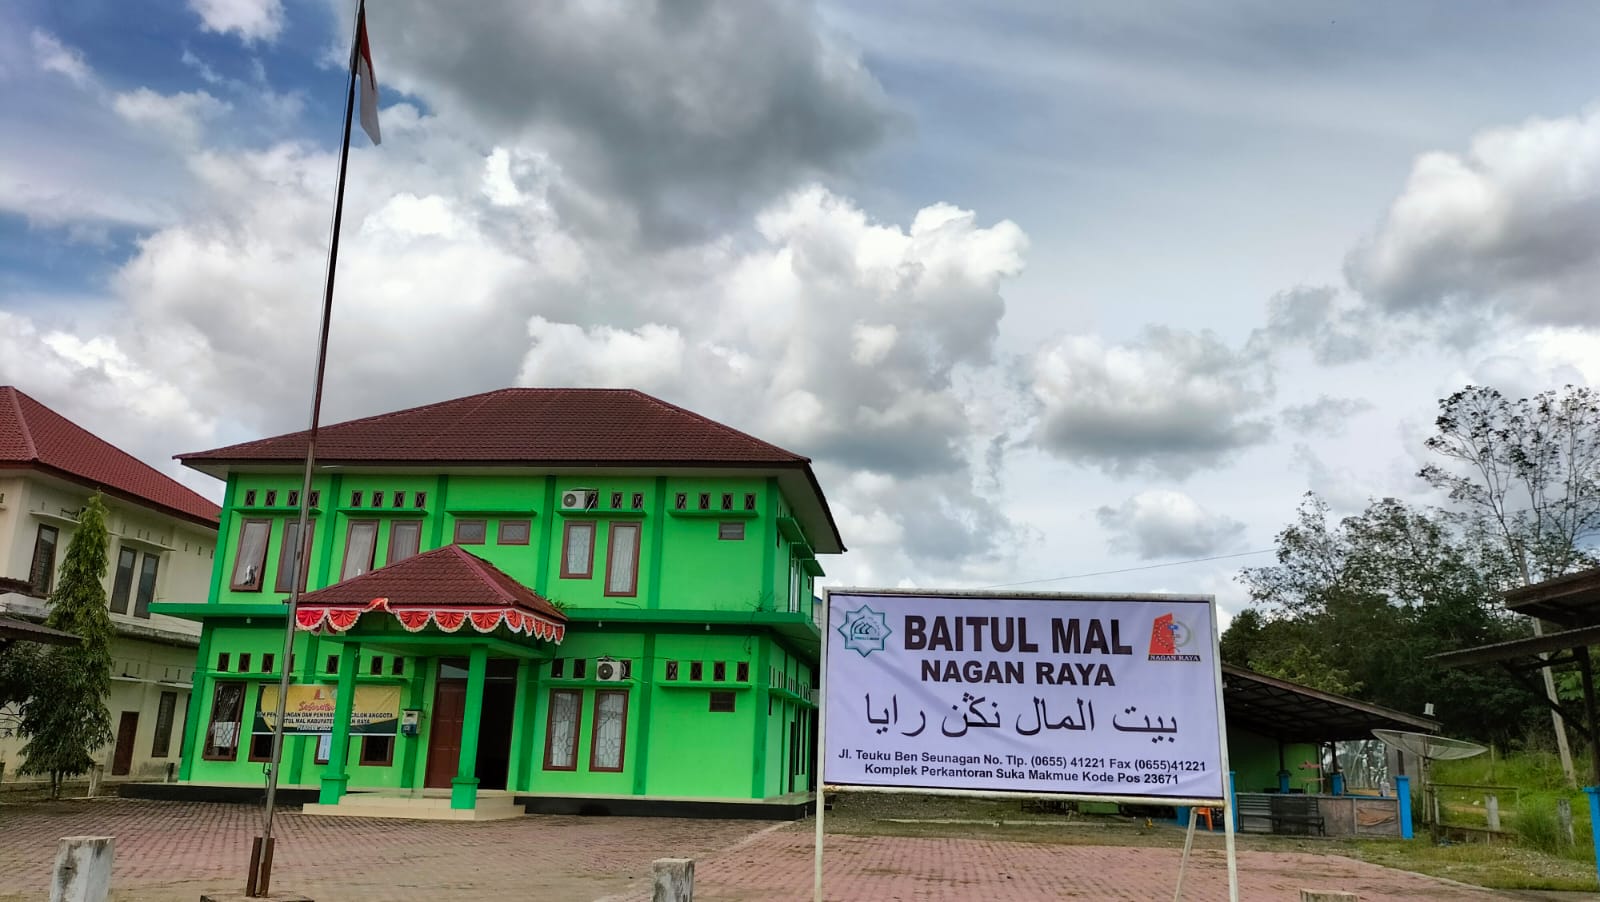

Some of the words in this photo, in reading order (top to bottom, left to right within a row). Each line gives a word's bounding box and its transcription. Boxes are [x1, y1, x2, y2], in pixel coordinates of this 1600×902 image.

[904, 615, 1038, 653] BAITUL
[1051, 618, 1132, 655] MAL
[921, 660, 1024, 684] NAGAN
[1036, 662, 1116, 686] RAYA
[865, 692, 926, 737] رايا
[1015, 695, 1095, 736] المال
[1112, 705, 1177, 744] بيت
[838, 748, 851, 759] Jl.
[856, 750, 891, 761] Teuku
[895, 751, 918, 762] Ben
[921, 752, 981, 766] Seunagan
[984, 755, 1003, 765] No.
[1005, 755, 1028, 767] Tlp.
[1031, 756, 1067, 769] (0655)
[1070, 758, 1105, 768] 41221
[1109, 758, 1131, 769] Fax
[865, 763, 918, 776] Komplek
[921, 765, 993, 778] Perkantoran
[996, 768, 1025, 780] Suka
[1028, 769, 1079, 781] Makmue
[1082, 772, 1114, 782] Kode
[1117, 773, 1141, 783] Pos
[1144, 773, 1179, 784] 23671
